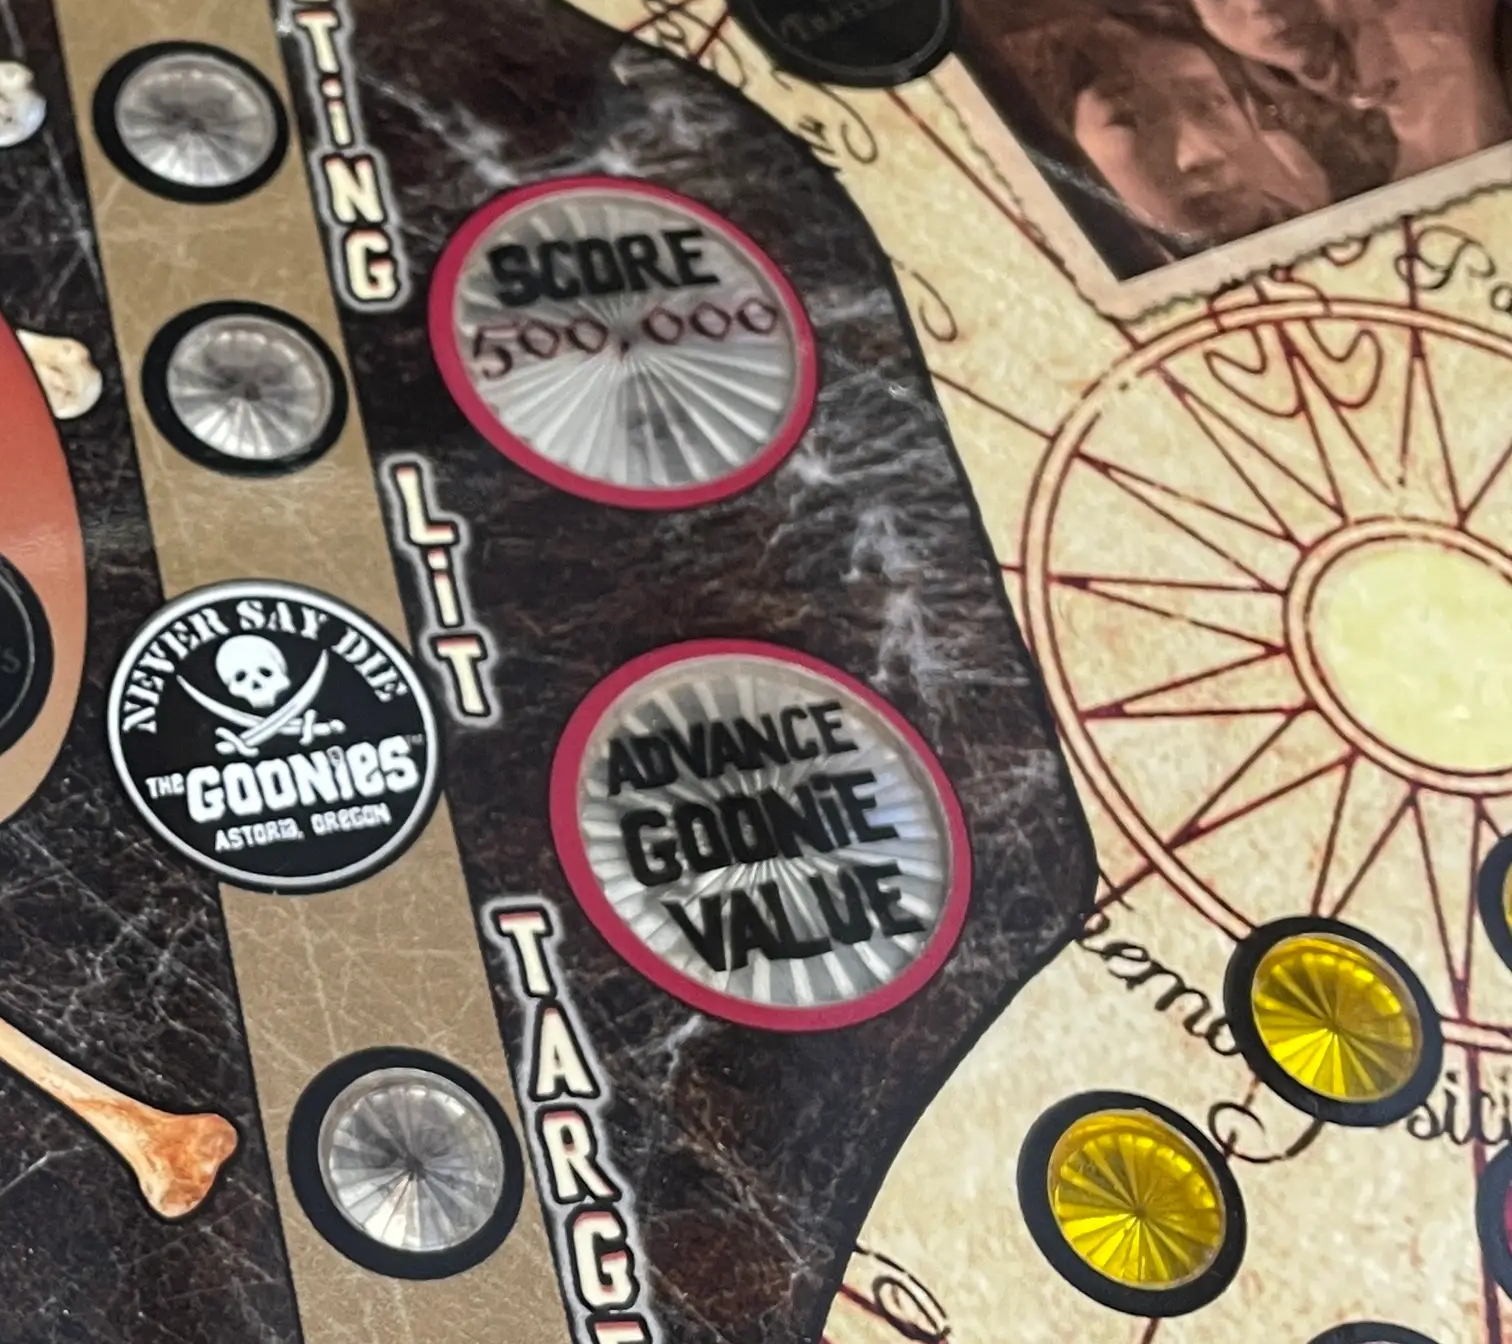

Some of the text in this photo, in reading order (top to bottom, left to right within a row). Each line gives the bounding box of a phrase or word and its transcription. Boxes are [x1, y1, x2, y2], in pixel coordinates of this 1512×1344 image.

[490, 229, 721, 307] SCORE
[122, 600, 409, 735] NEVER SAY DIE
[607, 700, 859, 797] ADVANCE
[661, 861, 928, 972] VALUE
